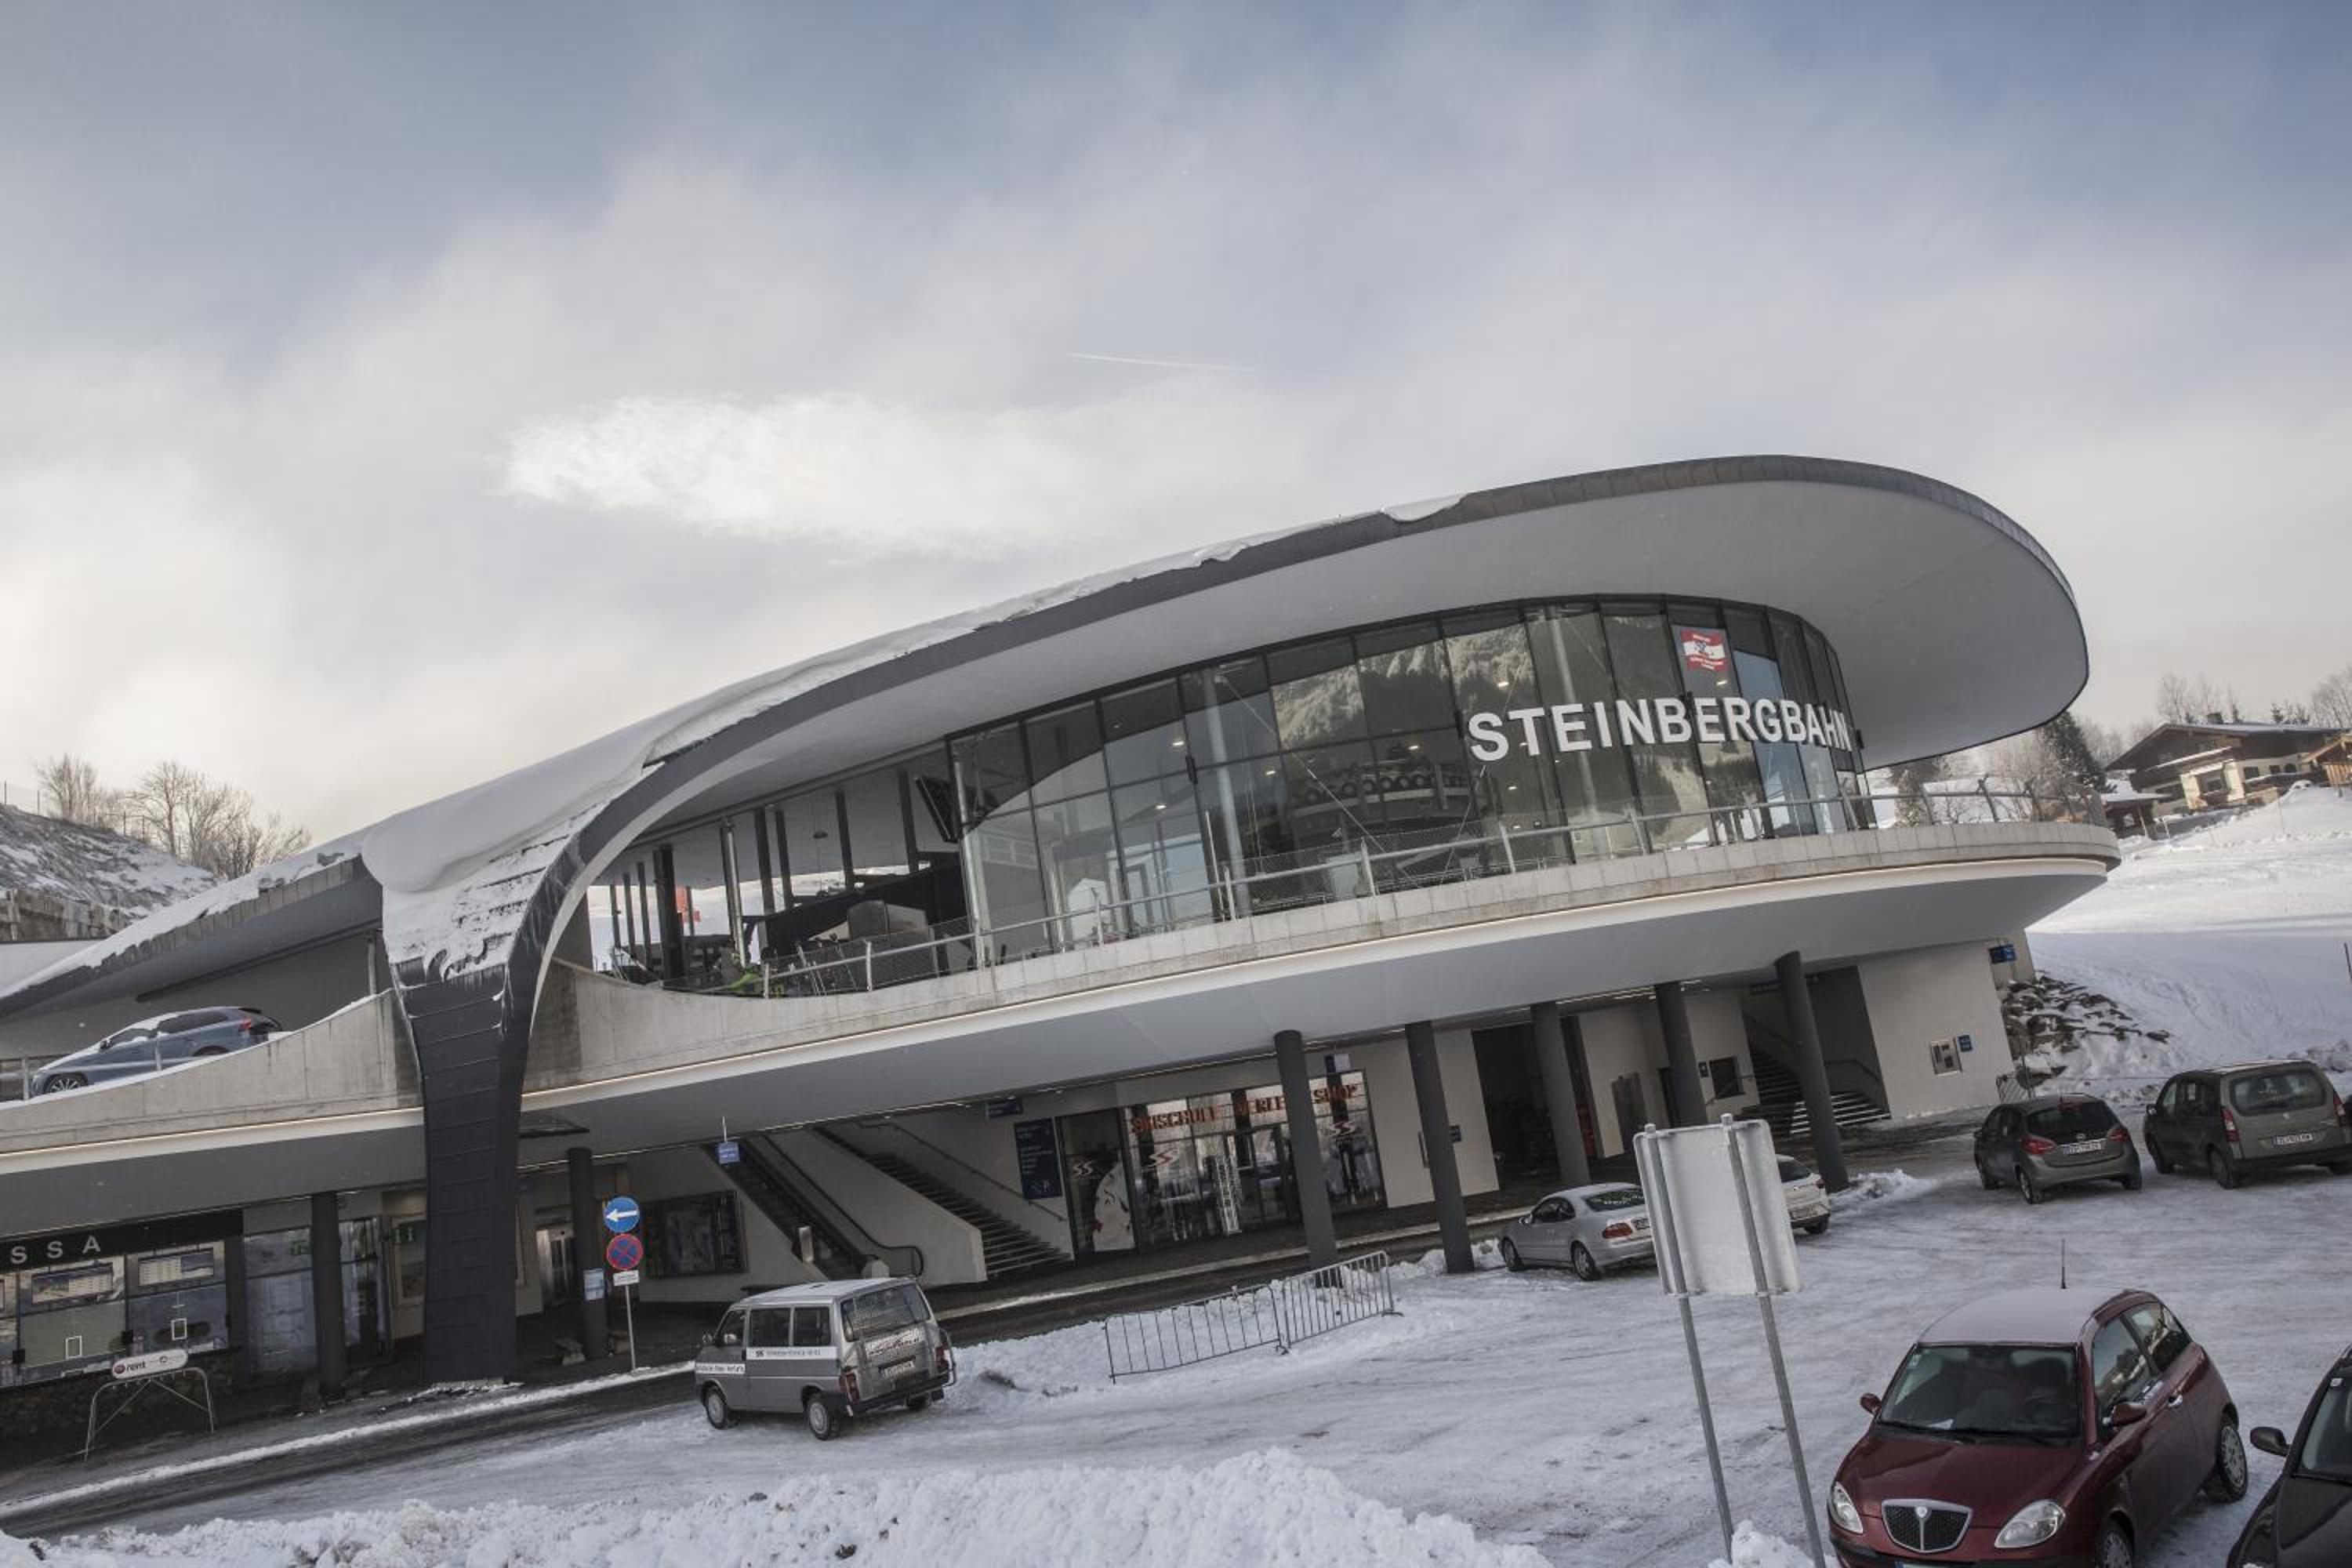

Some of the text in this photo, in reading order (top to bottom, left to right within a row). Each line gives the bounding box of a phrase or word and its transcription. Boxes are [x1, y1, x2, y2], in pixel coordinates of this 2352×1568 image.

[1468, 696, 1854, 761] STEINBERGBAHN
[10, 1235, 101, 1265] SSA
[126, 1360, 147, 1373] rent
